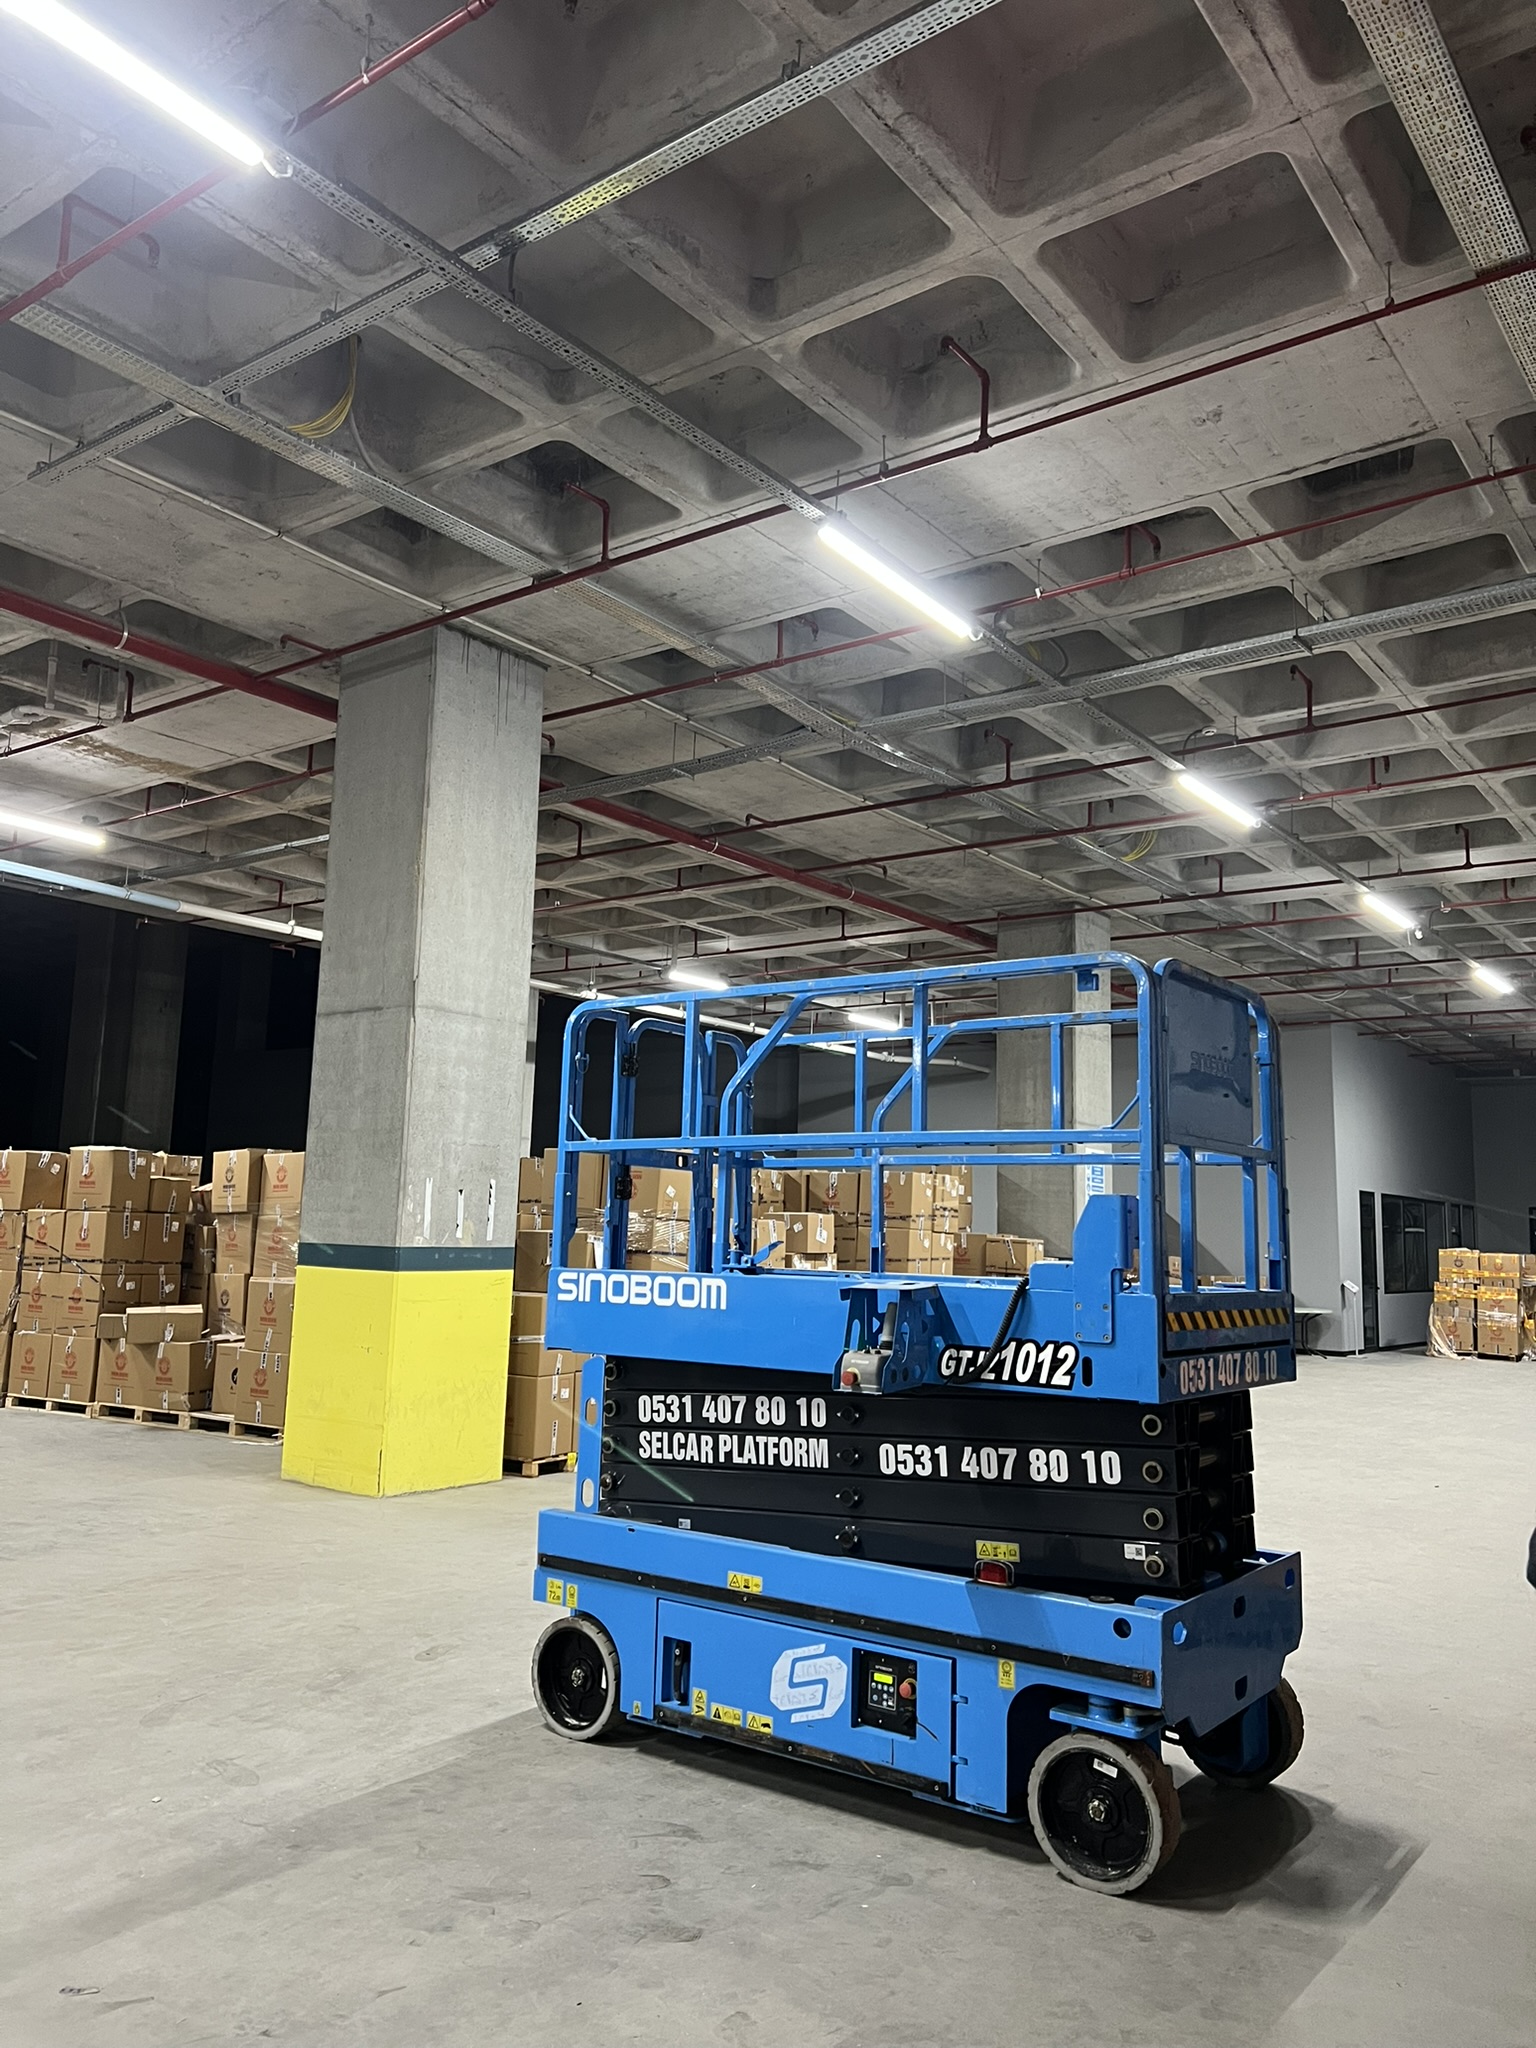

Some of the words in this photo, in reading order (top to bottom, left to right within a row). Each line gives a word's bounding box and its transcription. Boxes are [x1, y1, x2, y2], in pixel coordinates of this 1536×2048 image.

[557, 1272, 727, 1310] SINOBOOM
[1179, 1357, 1215, 1395] 0531
[1218, 1353, 1241, 1387] 407
[1245, 1351, 1260, 1383] 80
[1264, 1349, 1277, 1381] 10
[638, 1394, 693, 1423] 0531
[702, 1395, 747, 1424] 407
[755, 1395, 786, 1426] 80
[796, 1397, 827, 1428] 10
[638, 1430, 714, 1464] SELCAR
[718, 1434, 829, 1469] PLATFORM
[878, 1443, 948, 1477] 0531
[961, 1446, 1017, 1480] 407
[1028, 1448, 1069, 1483] 80
[1081, 1450, 1122, 1485] 10
